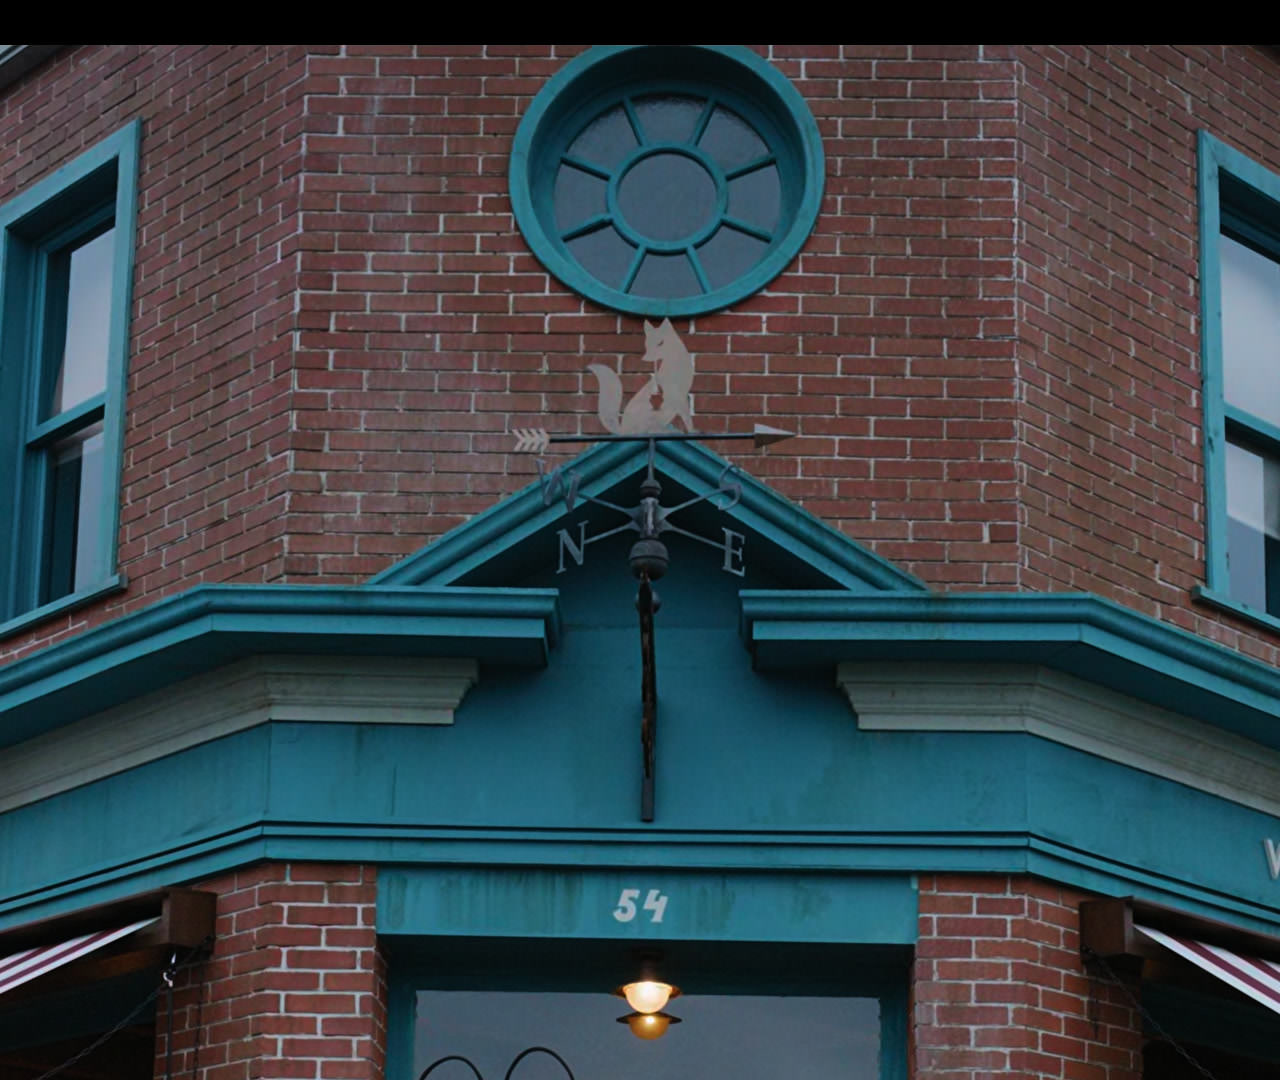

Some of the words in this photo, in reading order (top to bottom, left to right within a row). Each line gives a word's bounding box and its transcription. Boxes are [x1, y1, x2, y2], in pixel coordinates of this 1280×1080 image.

[556, 520, 589, 574] N
[722, 527, 746, 577] E
[613, 889, 668, 922] 54
